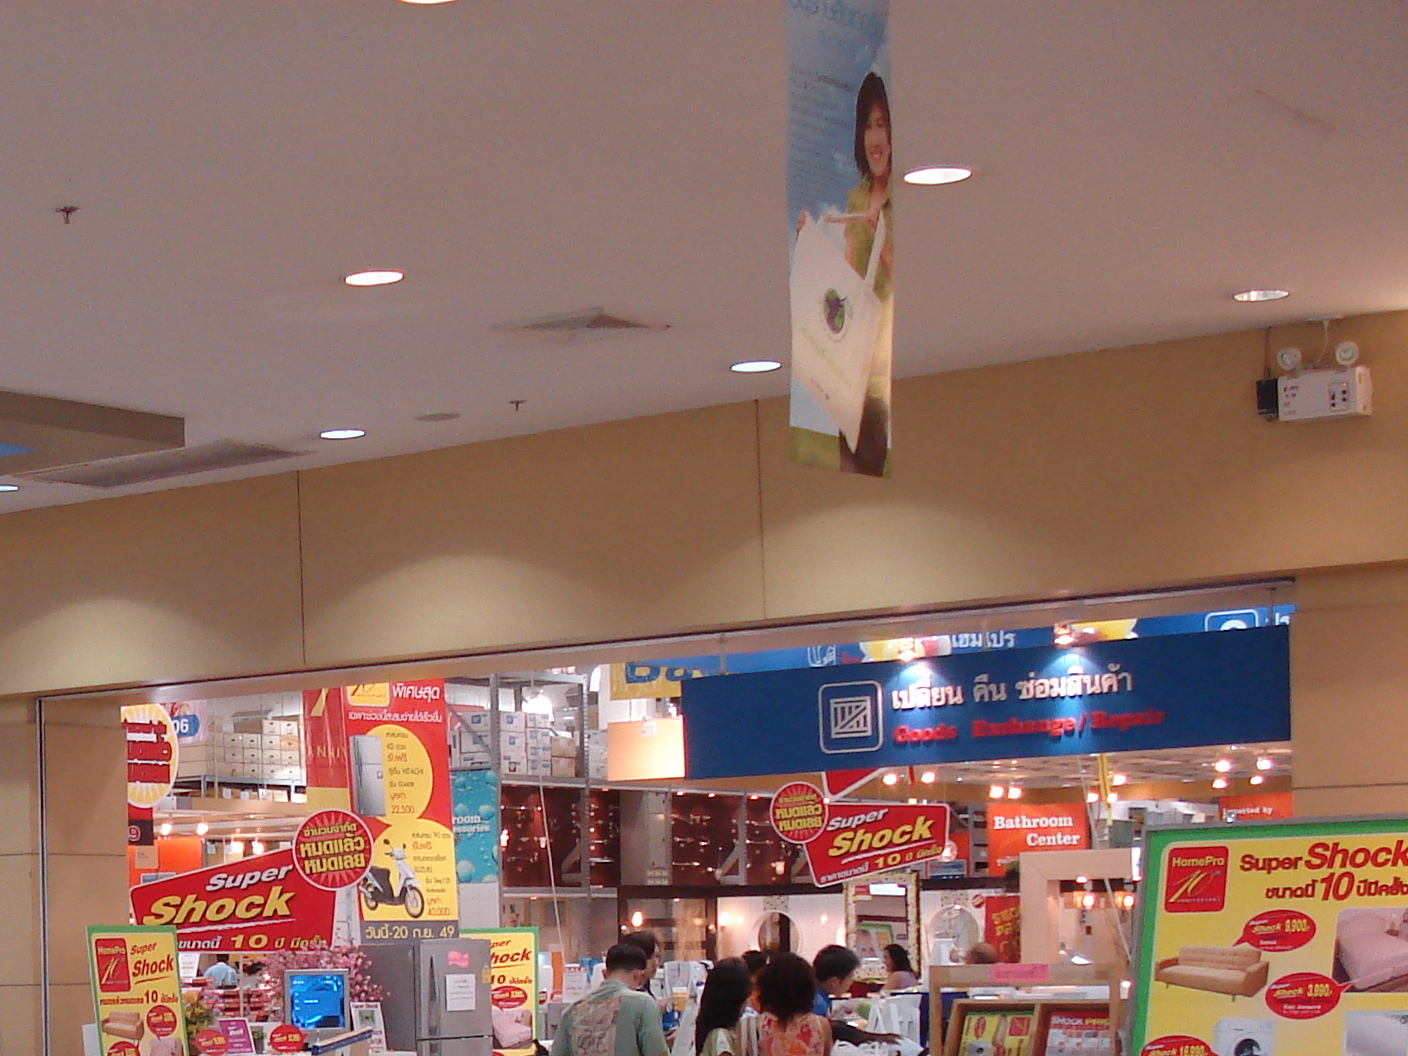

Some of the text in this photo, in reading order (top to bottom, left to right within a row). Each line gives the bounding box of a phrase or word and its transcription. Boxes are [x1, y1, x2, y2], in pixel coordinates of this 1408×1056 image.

[392, 682, 440, 703] พิเศษสุด
[892, 663, 1132, 710] เปลี่ยน คืน ซ่อมสินค้า
[894, 724, 958, 743] Goods
[971, 714, 1076, 738] Exchange
[1090, 708, 1166, 731] Repair
[452, 815, 481, 824] room
[827, 808, 888, 831] Super
[993, 815, 1074, 830] Bathroom
[300, 833, 366, 858] หมดแล้ว
[828, 815, 936, 857] Shock
[1026, 832, 1081, 847] Center
[304, 852, 367, 875] หมดเลย
[875, 855, 902, 870] 10
[1172, 856, 1224, 868] HomePro
[1240, 840, 1408, 874] Super Shock
[206, 864, 293, 892] Super
[1320, 871, 1355, 901] 10
[143, 885, 295, 926] Shock
[130, 943, 157, 956] Super
[178, 936, 221, 950] ขนาดนี้
[231, 934, 268, 949] 10
[490, 938, 511, 950] per
[132, 954, 174, 977] Shock
[490, 948, 531, 965] hock
[144, 990, 158, 1003] 10
